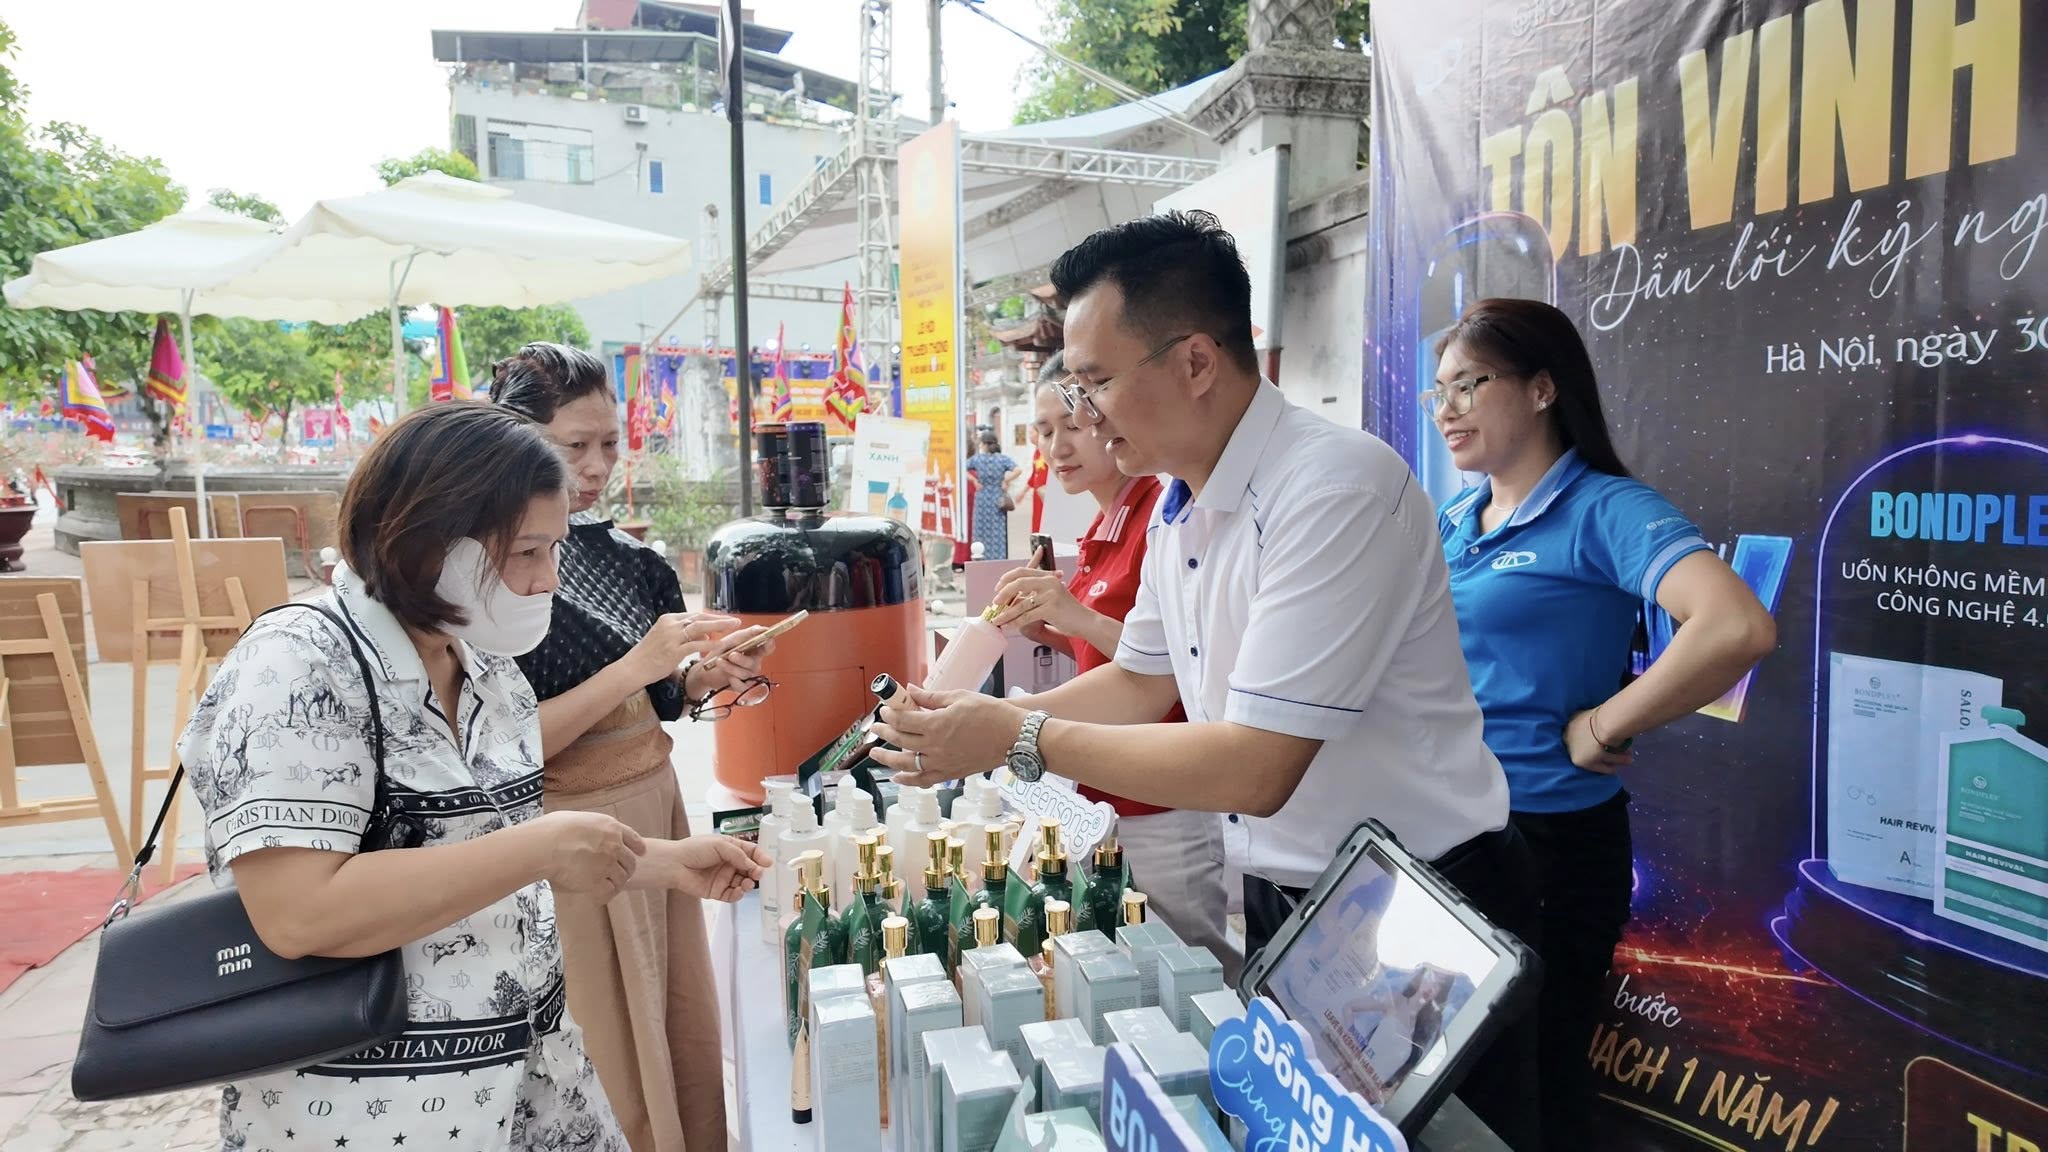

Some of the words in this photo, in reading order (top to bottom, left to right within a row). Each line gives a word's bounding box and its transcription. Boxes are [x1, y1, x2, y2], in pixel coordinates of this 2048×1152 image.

[1482, 65, 1639, 264] TÔN
[1679, 0, 2021, 230] VINH
[1590, 242, 1715, 331] Dẫn
[1726, 222, 1817, 290] lối
[1827, 199, 1938, 299] kỷ
[1954, 193, 2048, 281] ng
[1766, 342, 1806, 374] Hà
[1819, 334, 1882, 373] Nội,
[1896, 325, 1999, 369] ngày
[1870, 492, 2048, 546] BONDPLE
[1842, 558, 1887, 583] UỐN
[1894, 564, 1977, 592] KHÔNG
[1984, 568, 2046, 597] MỀM
[1877, 589, 1941, 616] CÔNG
[1947, 599, 2016, 628] NGHỆ
[2022, 607, 2048, 628] 4.
[1959, 689, 1972, 731] SALO
[321, 808, 361, 829] DIOR
[1879, 816, 1904, 828] HAIR
[1899, 851, 1912, 865] A
[1965, 850, 1987, 862] HAIR
[1987, 856, 2026, 873] REVIVAL
[1614, 974, 1682, 1027] bước
[453, 1032, 506, 1056] DIOR
[1253, 1016, 1335, 1145] Đồng
[1674, 1057, 1698, 1104] 1
[1110, 1077, 1159, 1152] BO
